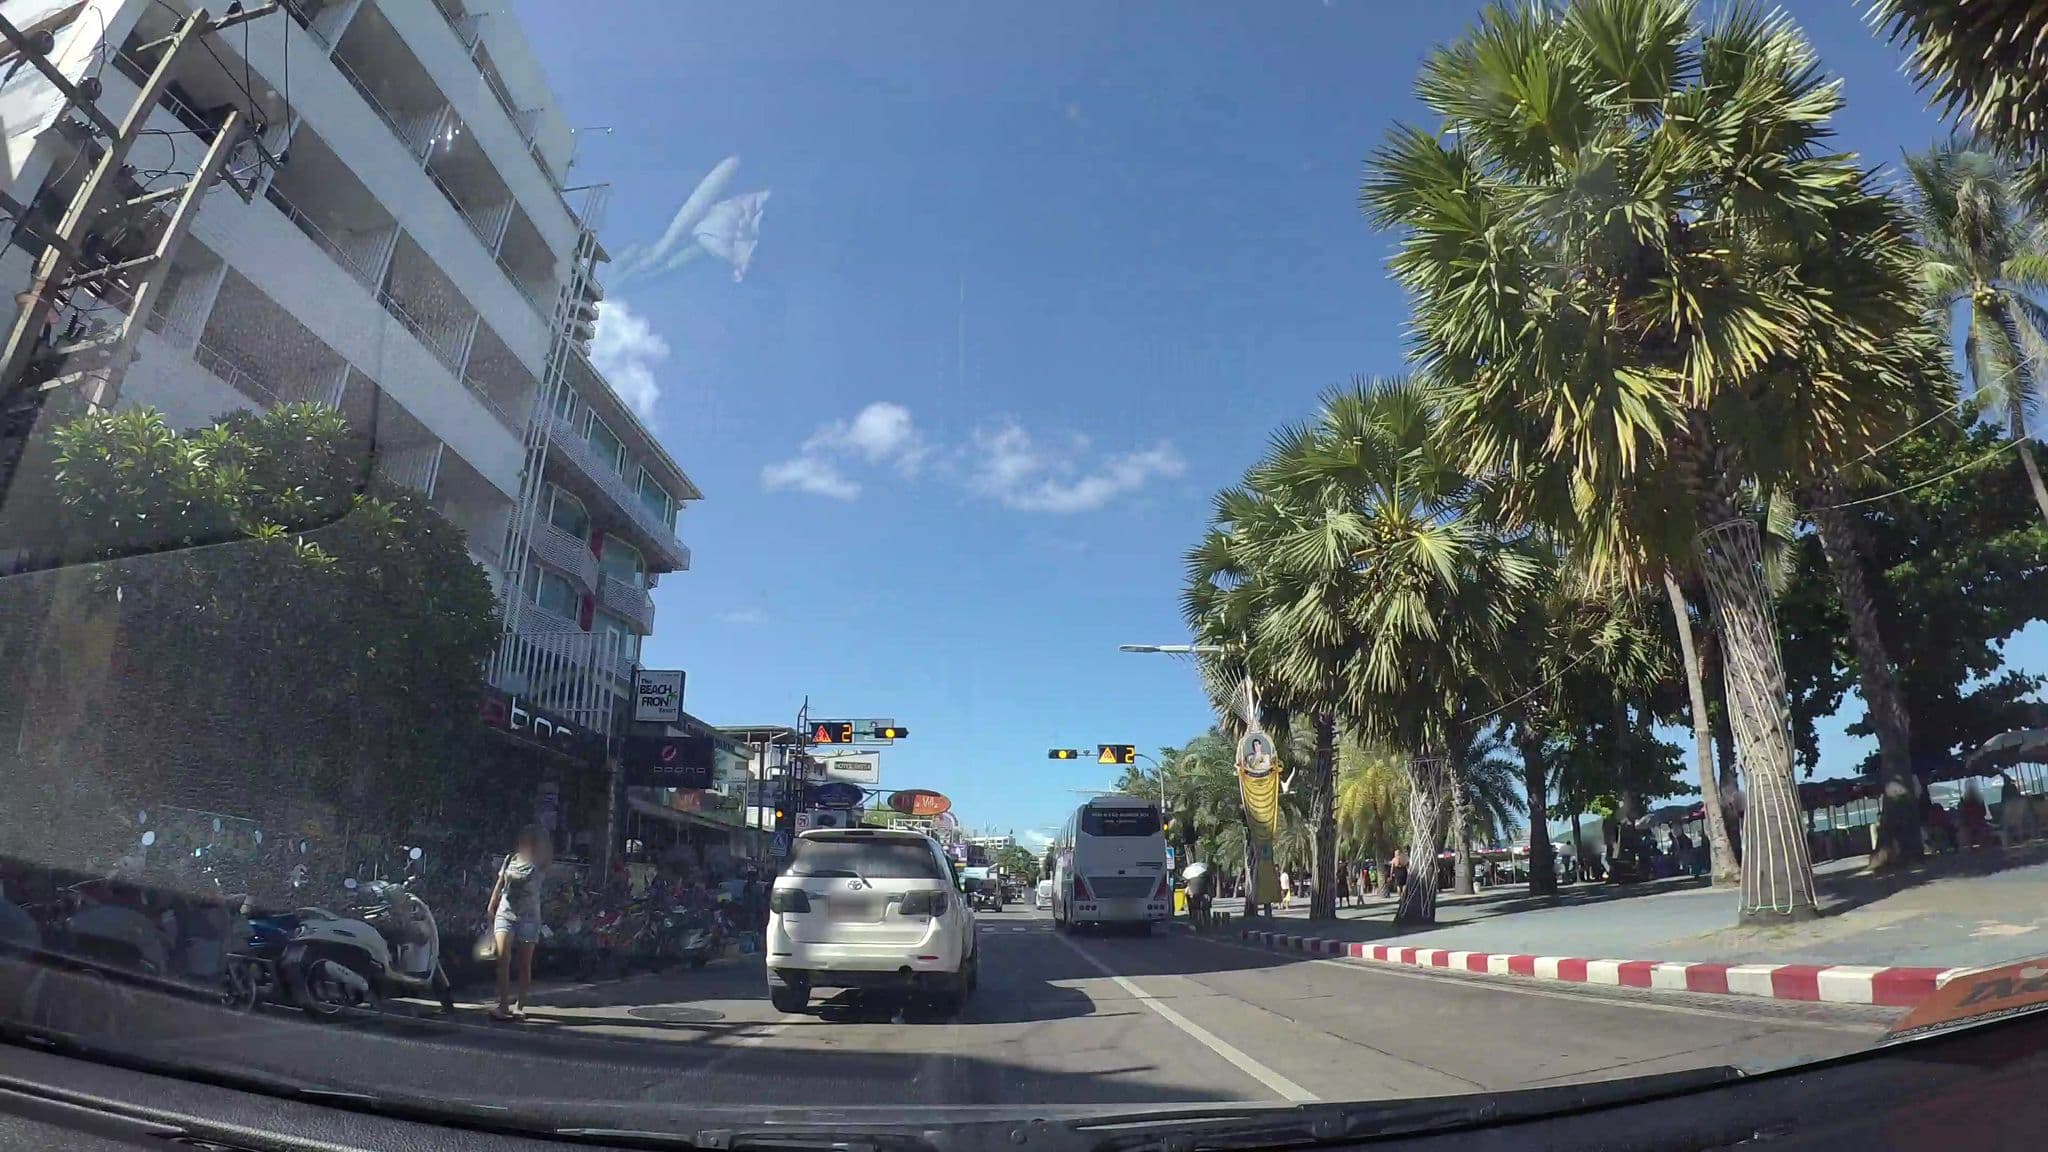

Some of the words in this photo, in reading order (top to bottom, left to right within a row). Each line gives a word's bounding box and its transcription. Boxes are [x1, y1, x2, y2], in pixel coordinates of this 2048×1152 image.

[640, 684, 672, 695] BEACH
[842, 724, 851, 742] 2
[1125, 747, 1135, 764] 2
